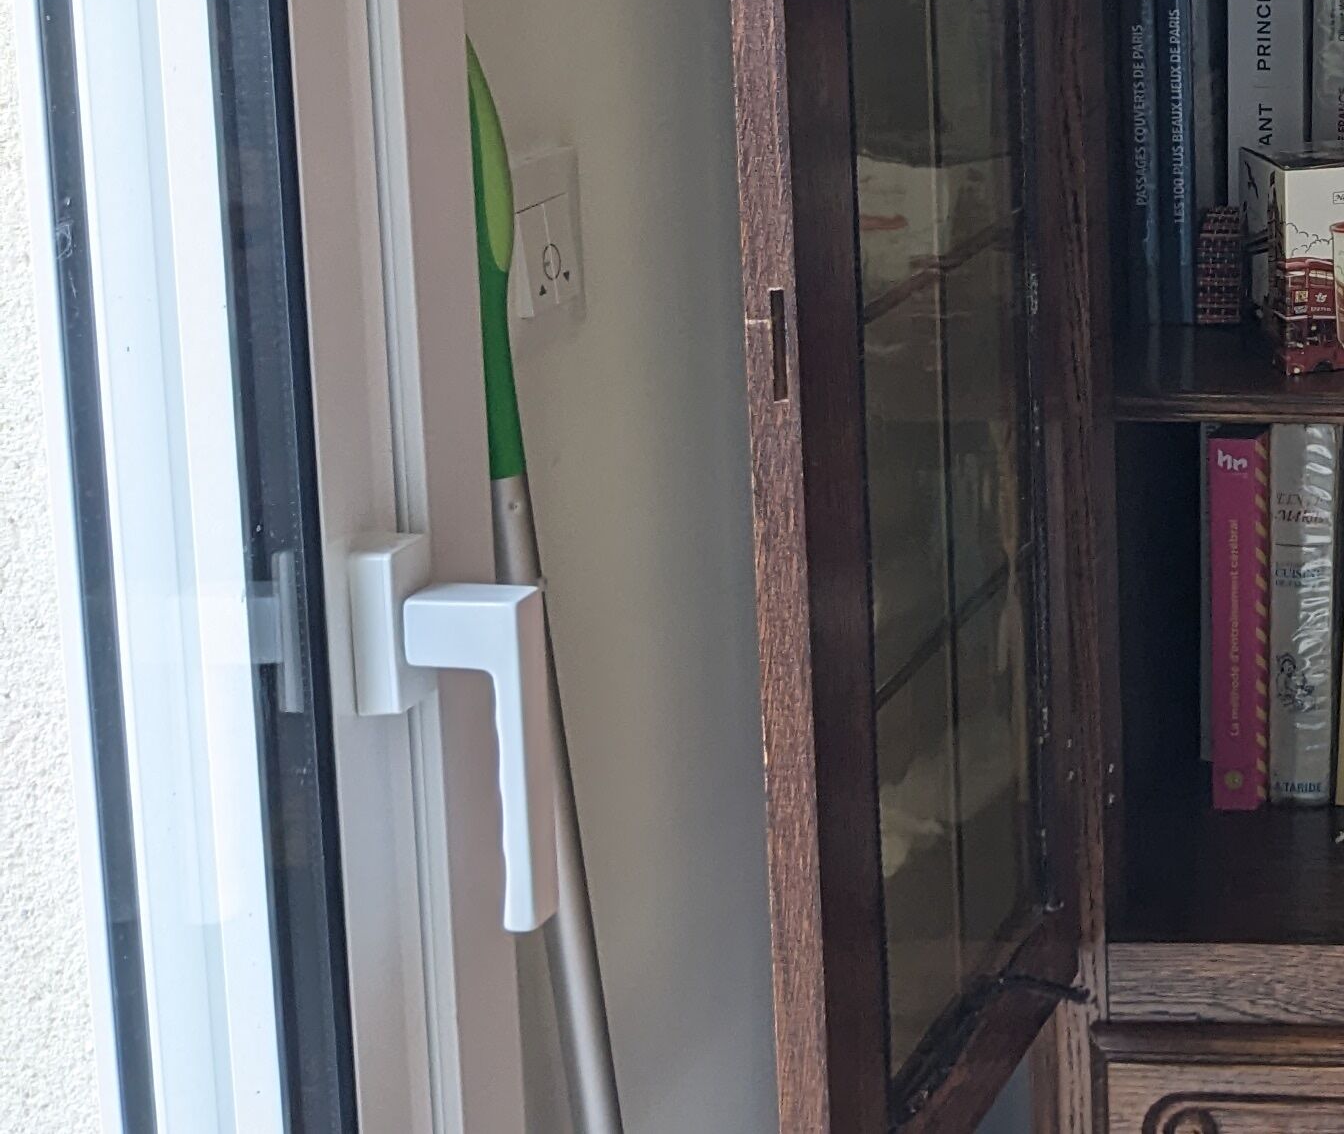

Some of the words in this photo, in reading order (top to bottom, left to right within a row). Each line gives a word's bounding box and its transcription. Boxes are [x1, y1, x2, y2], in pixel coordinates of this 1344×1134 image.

[1131, 24, 1144, 59] PARIS
[1168, 9, 1180, 44] PARIS
[1132, 62, 1145, 78] DE
[1169, 47, 1181, 63] DE
[1170, 66, 1182, 100] LIEUX
[1132, 80, 1146, 143] COUVERTS
[1171, 102, 1183, 142] BEAUX
[1258, 102, 1273, 147] ANT
[1134, 145, 1148, 206] PASSAGES
[1171, 145, 1184, 175] PLUS
[1172, 178, 1185, 200] 100
[1173, 201, 1185, 224] LES
